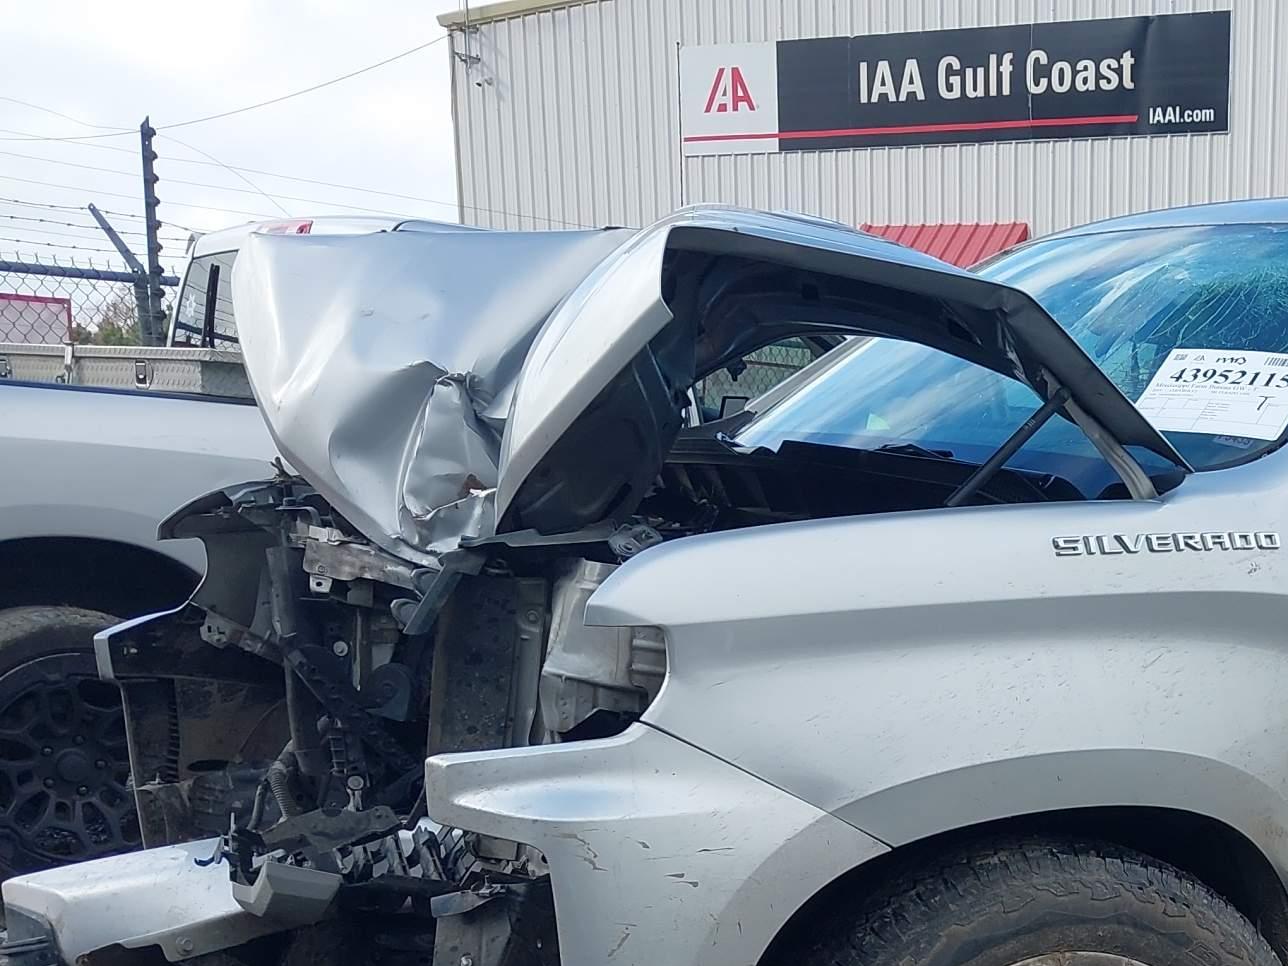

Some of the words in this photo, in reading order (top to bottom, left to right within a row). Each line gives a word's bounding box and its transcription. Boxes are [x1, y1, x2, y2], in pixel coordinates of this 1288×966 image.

[859, 59, 926, 104] IAA
[937, 52, 1013, 100] Gulf
[1026, 48, 1136, 96] Coast
[1148, 105, 1215, 126] IAAI.com
[1052, 531, 1280, 556] SILVERADO
